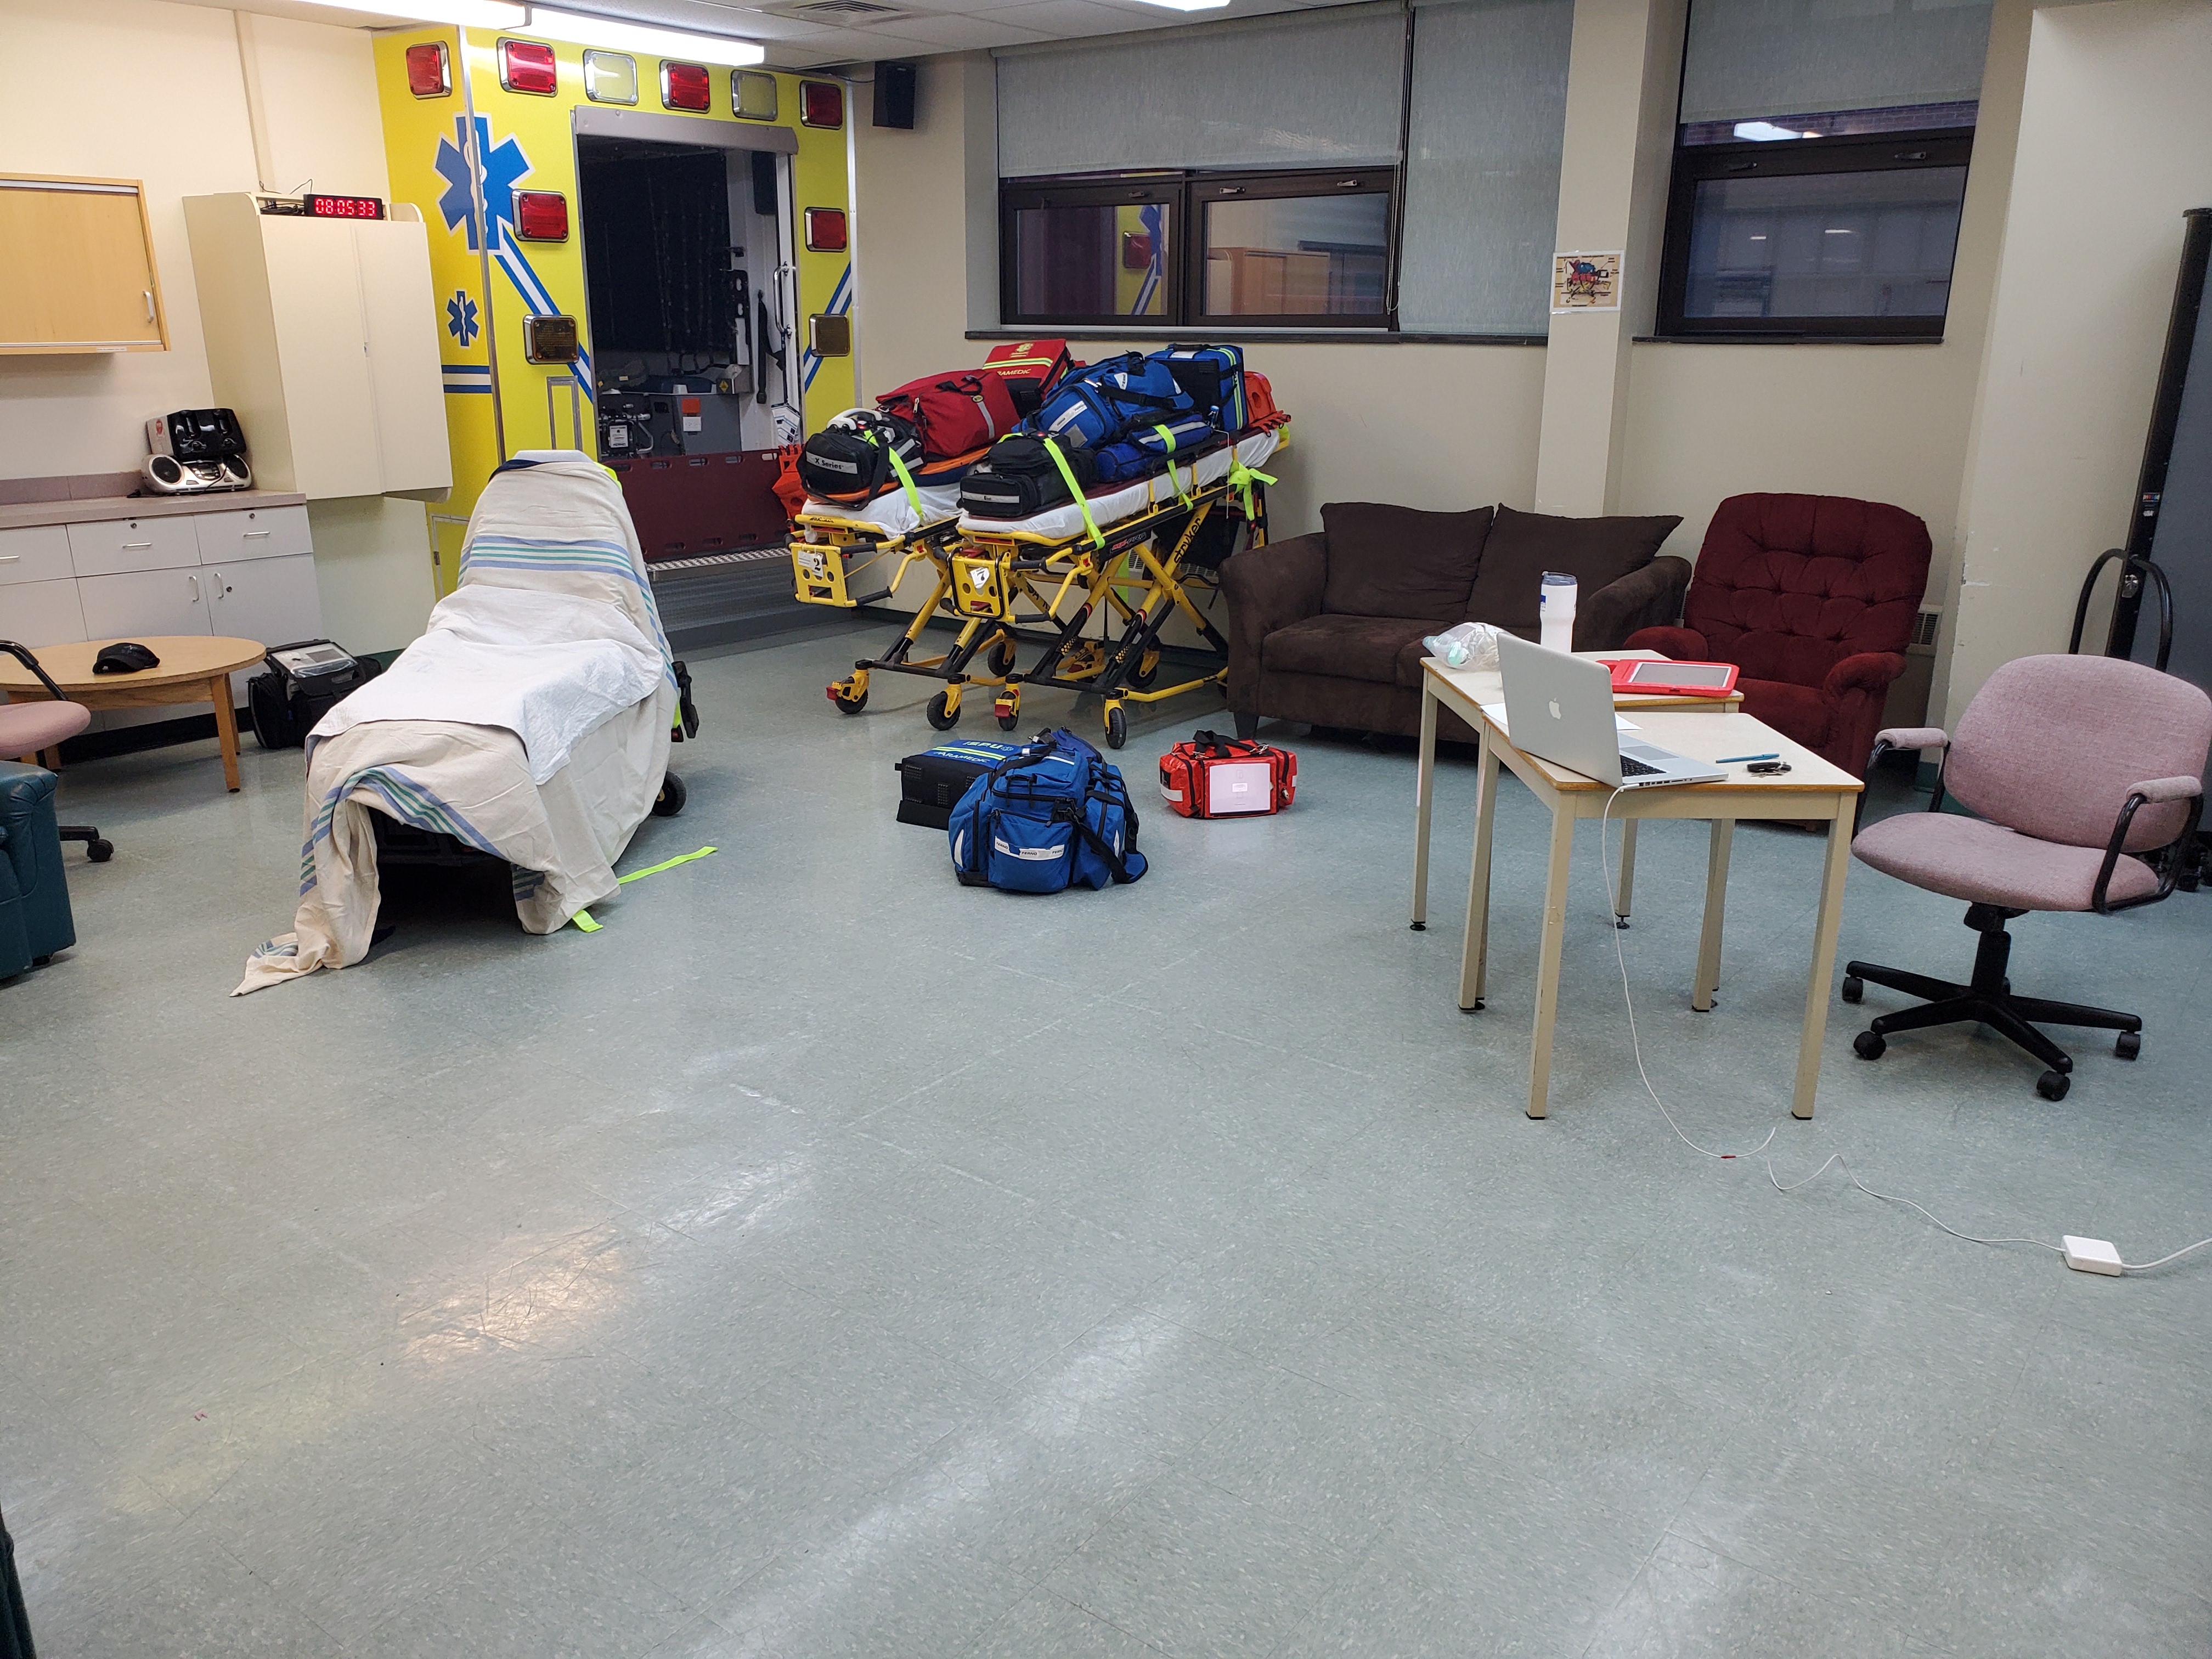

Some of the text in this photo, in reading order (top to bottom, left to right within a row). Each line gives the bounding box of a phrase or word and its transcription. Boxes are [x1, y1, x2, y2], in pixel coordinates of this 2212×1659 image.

[315, 198, 376, 216] 08:05:33
[822, 460, 842, 469] Series
[1173, 517, 1201, 563] stryker
[813, 558, 821, 571] 2
